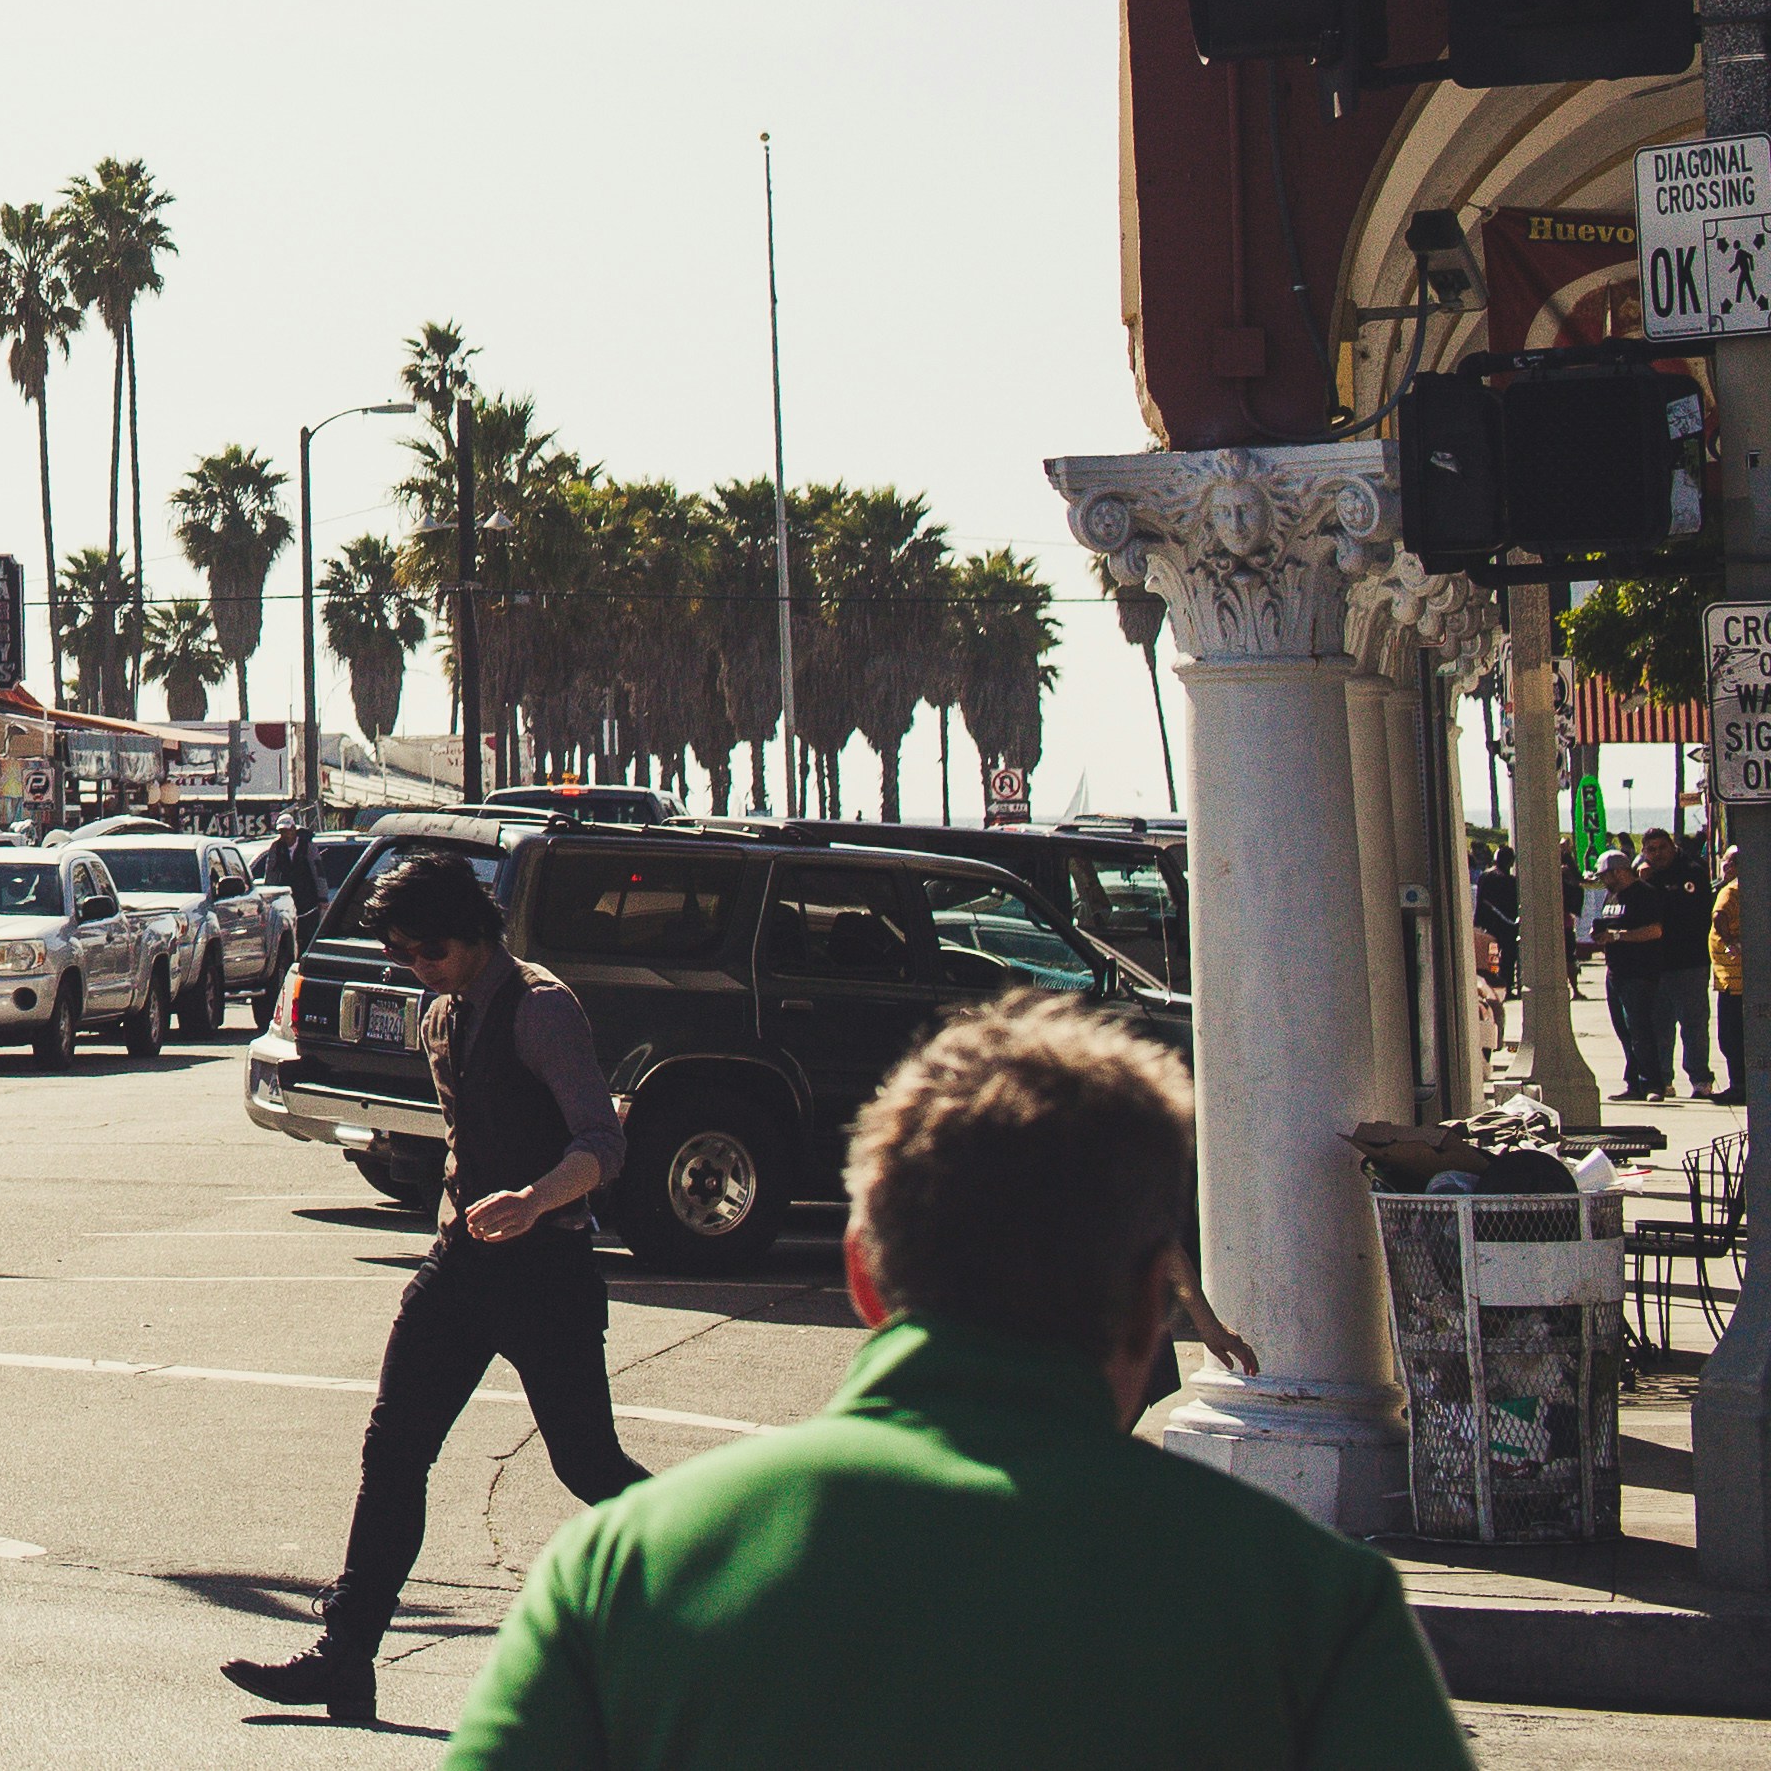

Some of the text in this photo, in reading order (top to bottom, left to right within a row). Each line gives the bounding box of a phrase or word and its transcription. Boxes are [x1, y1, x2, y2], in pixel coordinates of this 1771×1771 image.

[1654, 143, 1752, 182] DIAGONAL
[1656, 176, 1755, 215] CROSSING
[1529, 218, 1635, 244] Huevo
[1650, 245, 1702, 318] OK
[1725, 721, 1771, 751] SIG
[1581, 784, 1600, 872] RENTA
